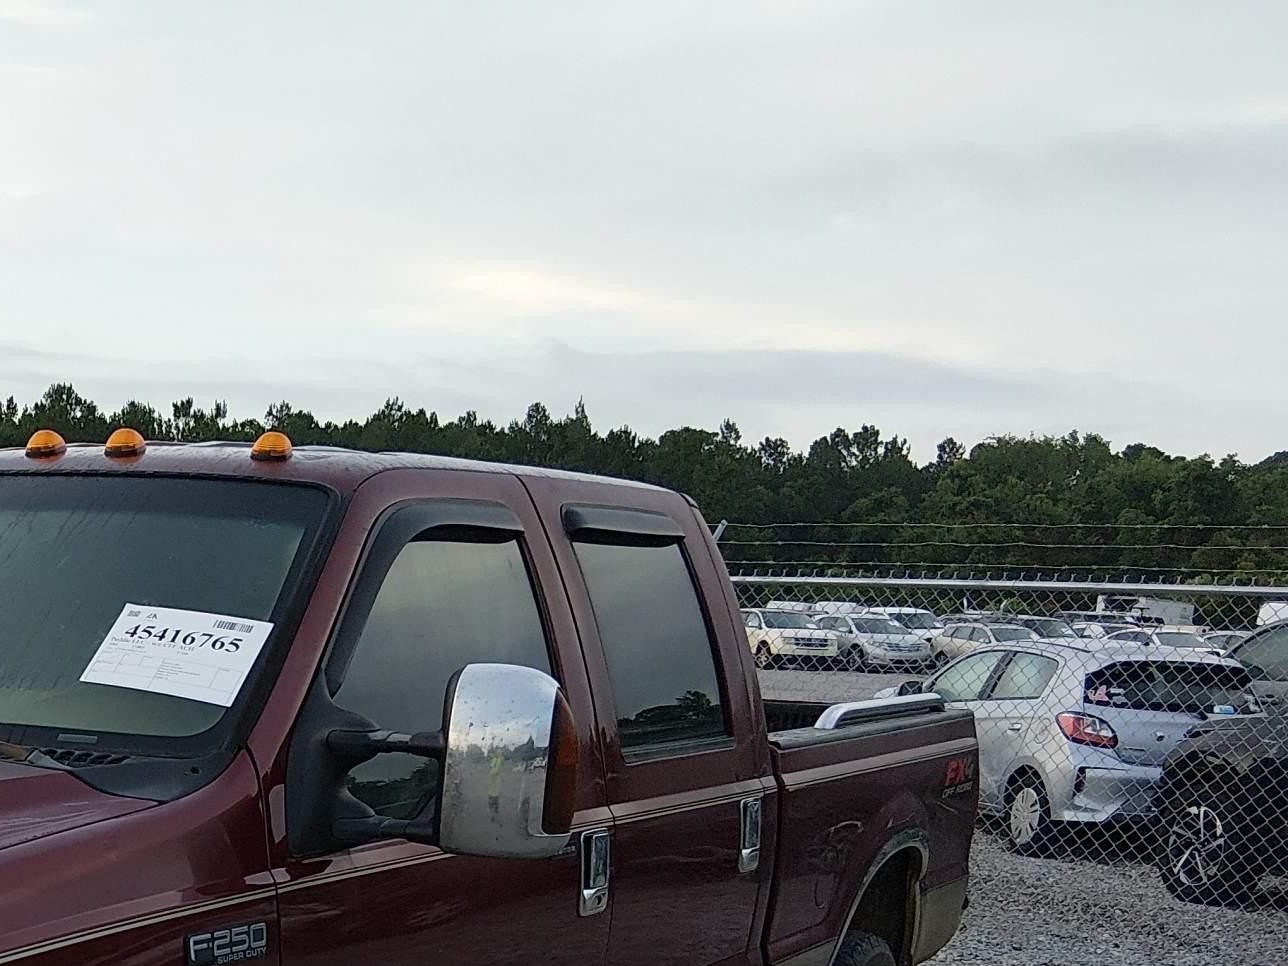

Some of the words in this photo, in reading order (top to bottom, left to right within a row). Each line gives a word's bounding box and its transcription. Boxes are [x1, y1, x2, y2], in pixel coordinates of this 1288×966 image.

[124, 623, 244, 653] 45416765
[217, 951, 244, 964] SUPER
[246, 947, 267, 958] DUTY
